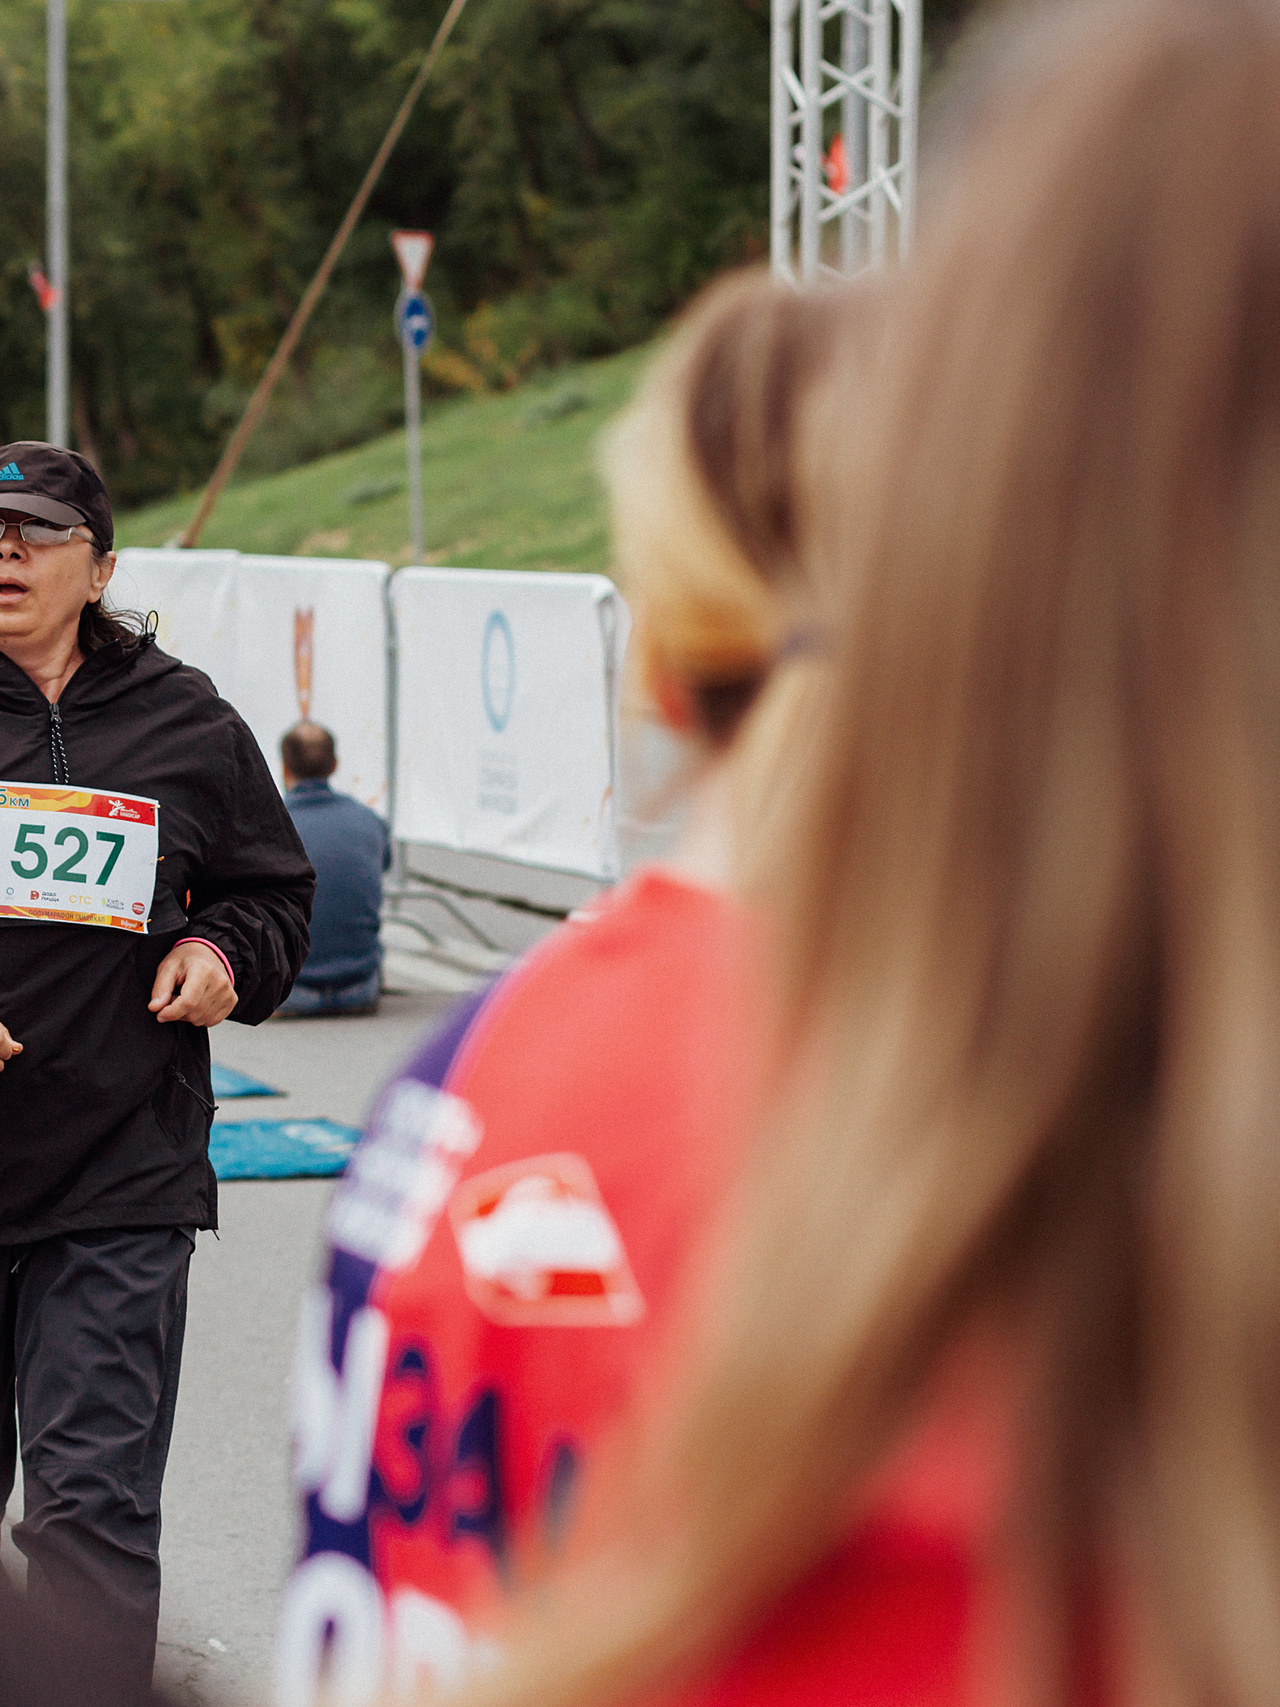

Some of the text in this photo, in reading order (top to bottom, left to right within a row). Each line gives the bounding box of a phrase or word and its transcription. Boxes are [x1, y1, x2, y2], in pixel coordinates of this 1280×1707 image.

[10, 823, 126, 886] 527
[69, 895, 92, 905] СТС
[28, 909, 106, 923] ПОЛУМАРАФОН ГАНДИКАП
